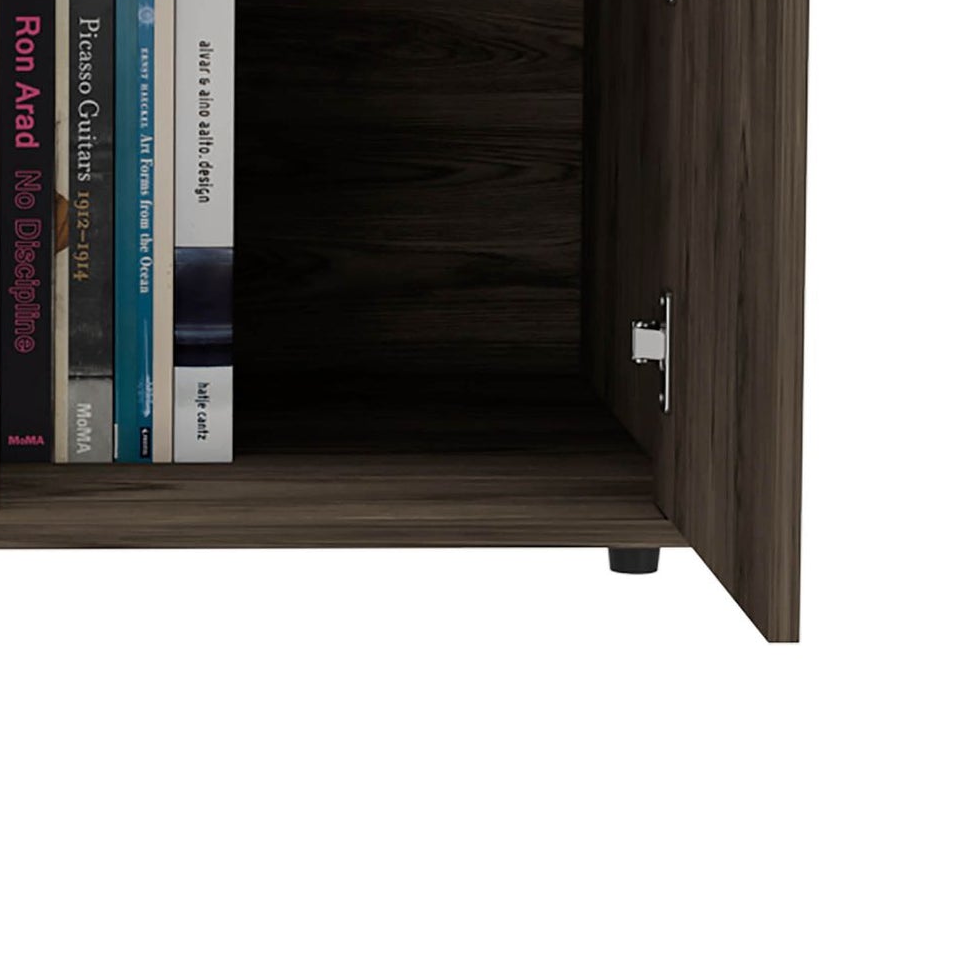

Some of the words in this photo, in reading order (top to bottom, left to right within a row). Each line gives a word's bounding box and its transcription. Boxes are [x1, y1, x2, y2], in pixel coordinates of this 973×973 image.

[14, 15, 42, 73] Ron
[78, 16, 101, 95] Picasso
[198, 40, 215, 75] alvar
[140, 47, 149, 80] ERNST
[14, 82, 41, 149] Arad
[198, 90, 214, 118] aino
[77, 99, 100, 182] Guitars
[140, 134, 153, 154] Art
[14, 170, 42, 210] No
[140, 158, 154, 196] Forms
[140, 200, 153, 230] from
[140, 233, 153, 253] the
[8, 217, 42, 354] Discipline
[140, 256, 154, 294] Ocean
[195, 382, 211, 409] hatje
[8, 434, 45, 446] MoMA
[76, 402, 92, 455] MoMA
[197, 412, 210, 441] cantz
